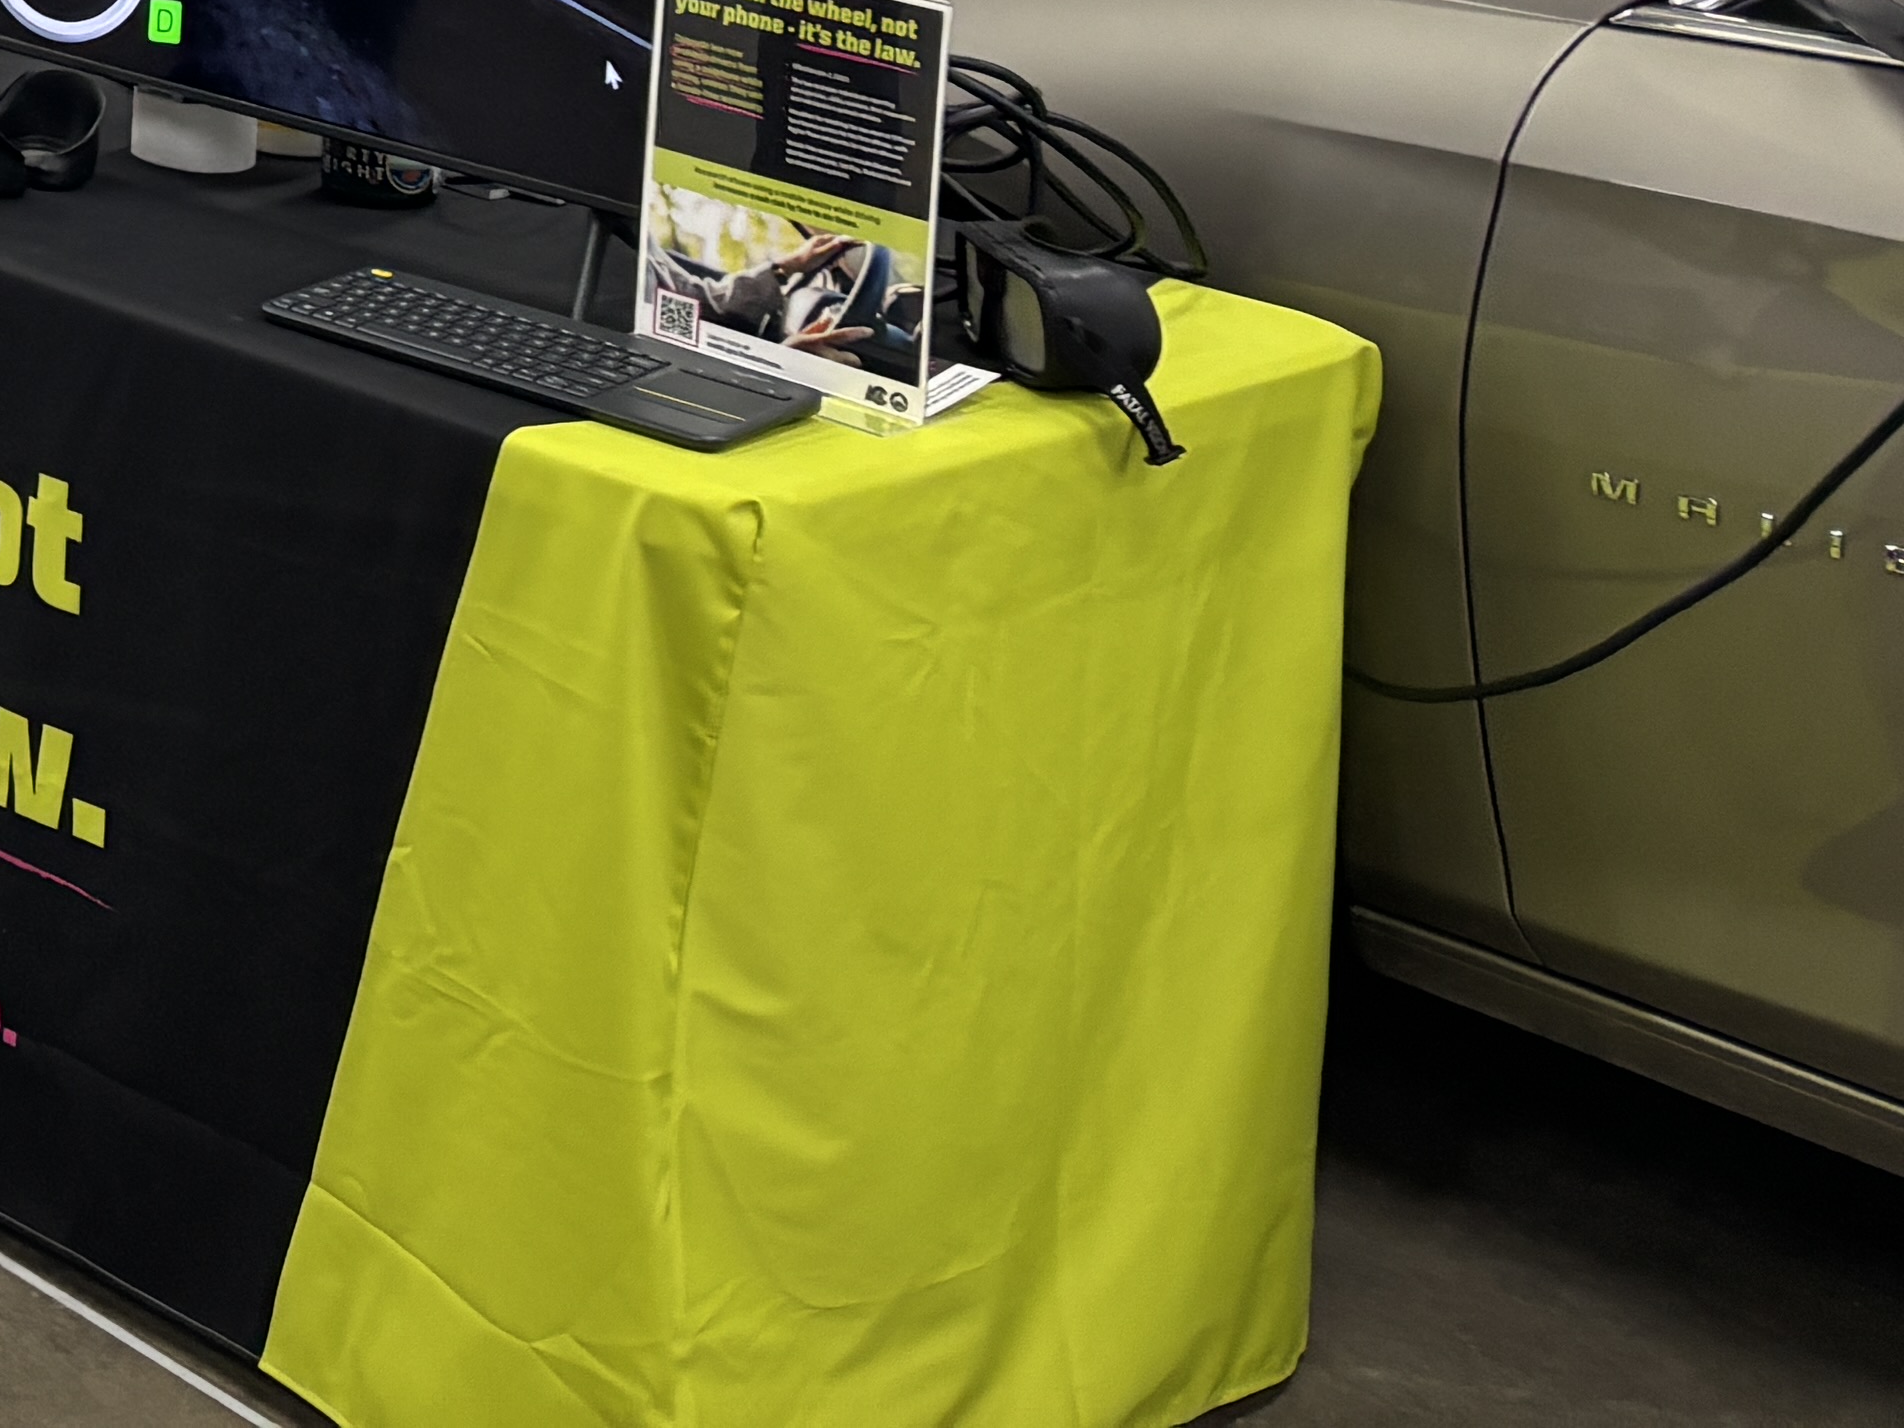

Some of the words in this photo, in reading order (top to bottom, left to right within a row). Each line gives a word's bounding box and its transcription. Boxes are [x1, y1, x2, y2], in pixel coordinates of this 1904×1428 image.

[157, 9, 174, 33] D
[722, 4, 785, 35] phone
[799, 20, 833, 45] it's
[835, 29, 872, 56] the
[874, 38, 921, 70] law.
[881, 16, 919, 41] not
[1111, 384, 1150, 425] FATAL
